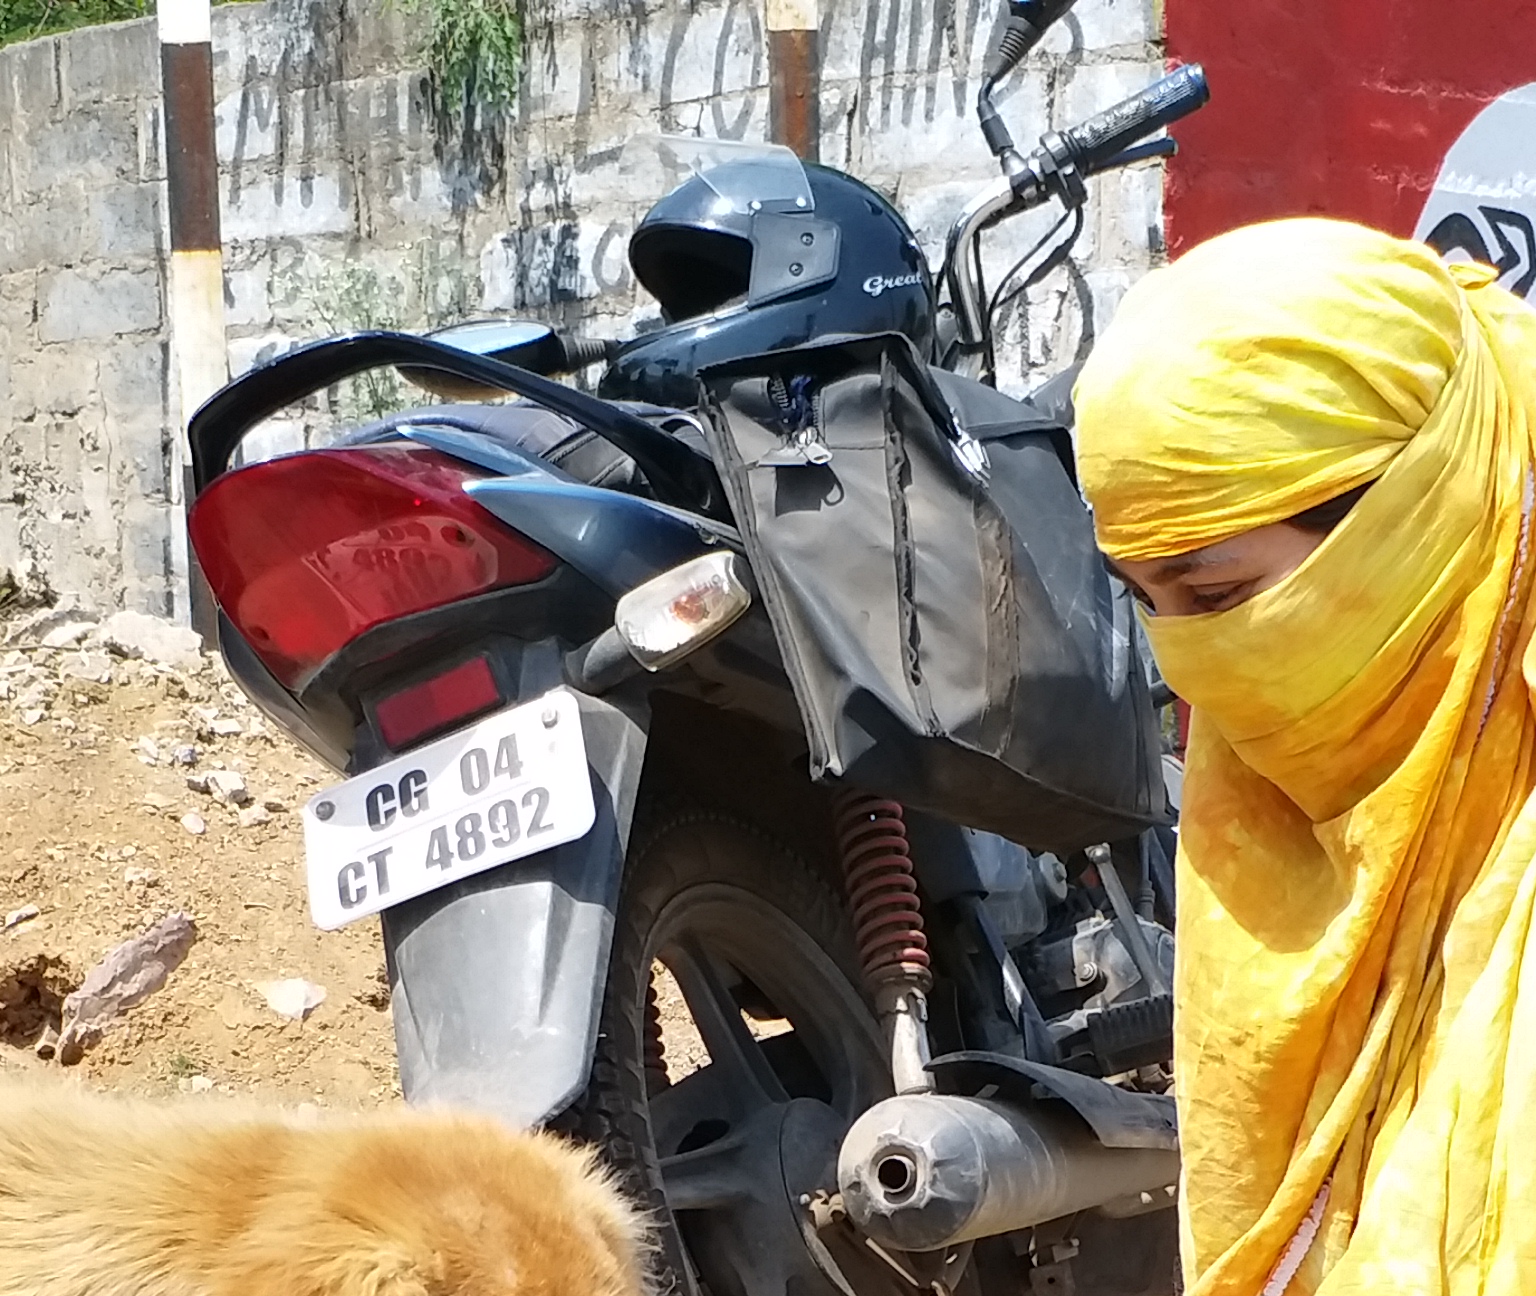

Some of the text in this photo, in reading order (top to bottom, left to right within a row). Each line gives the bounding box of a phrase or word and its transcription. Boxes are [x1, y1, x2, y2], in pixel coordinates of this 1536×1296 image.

[365, 732, 524, 833] CG 04
[337, 786, 556, 911] CT 4892
